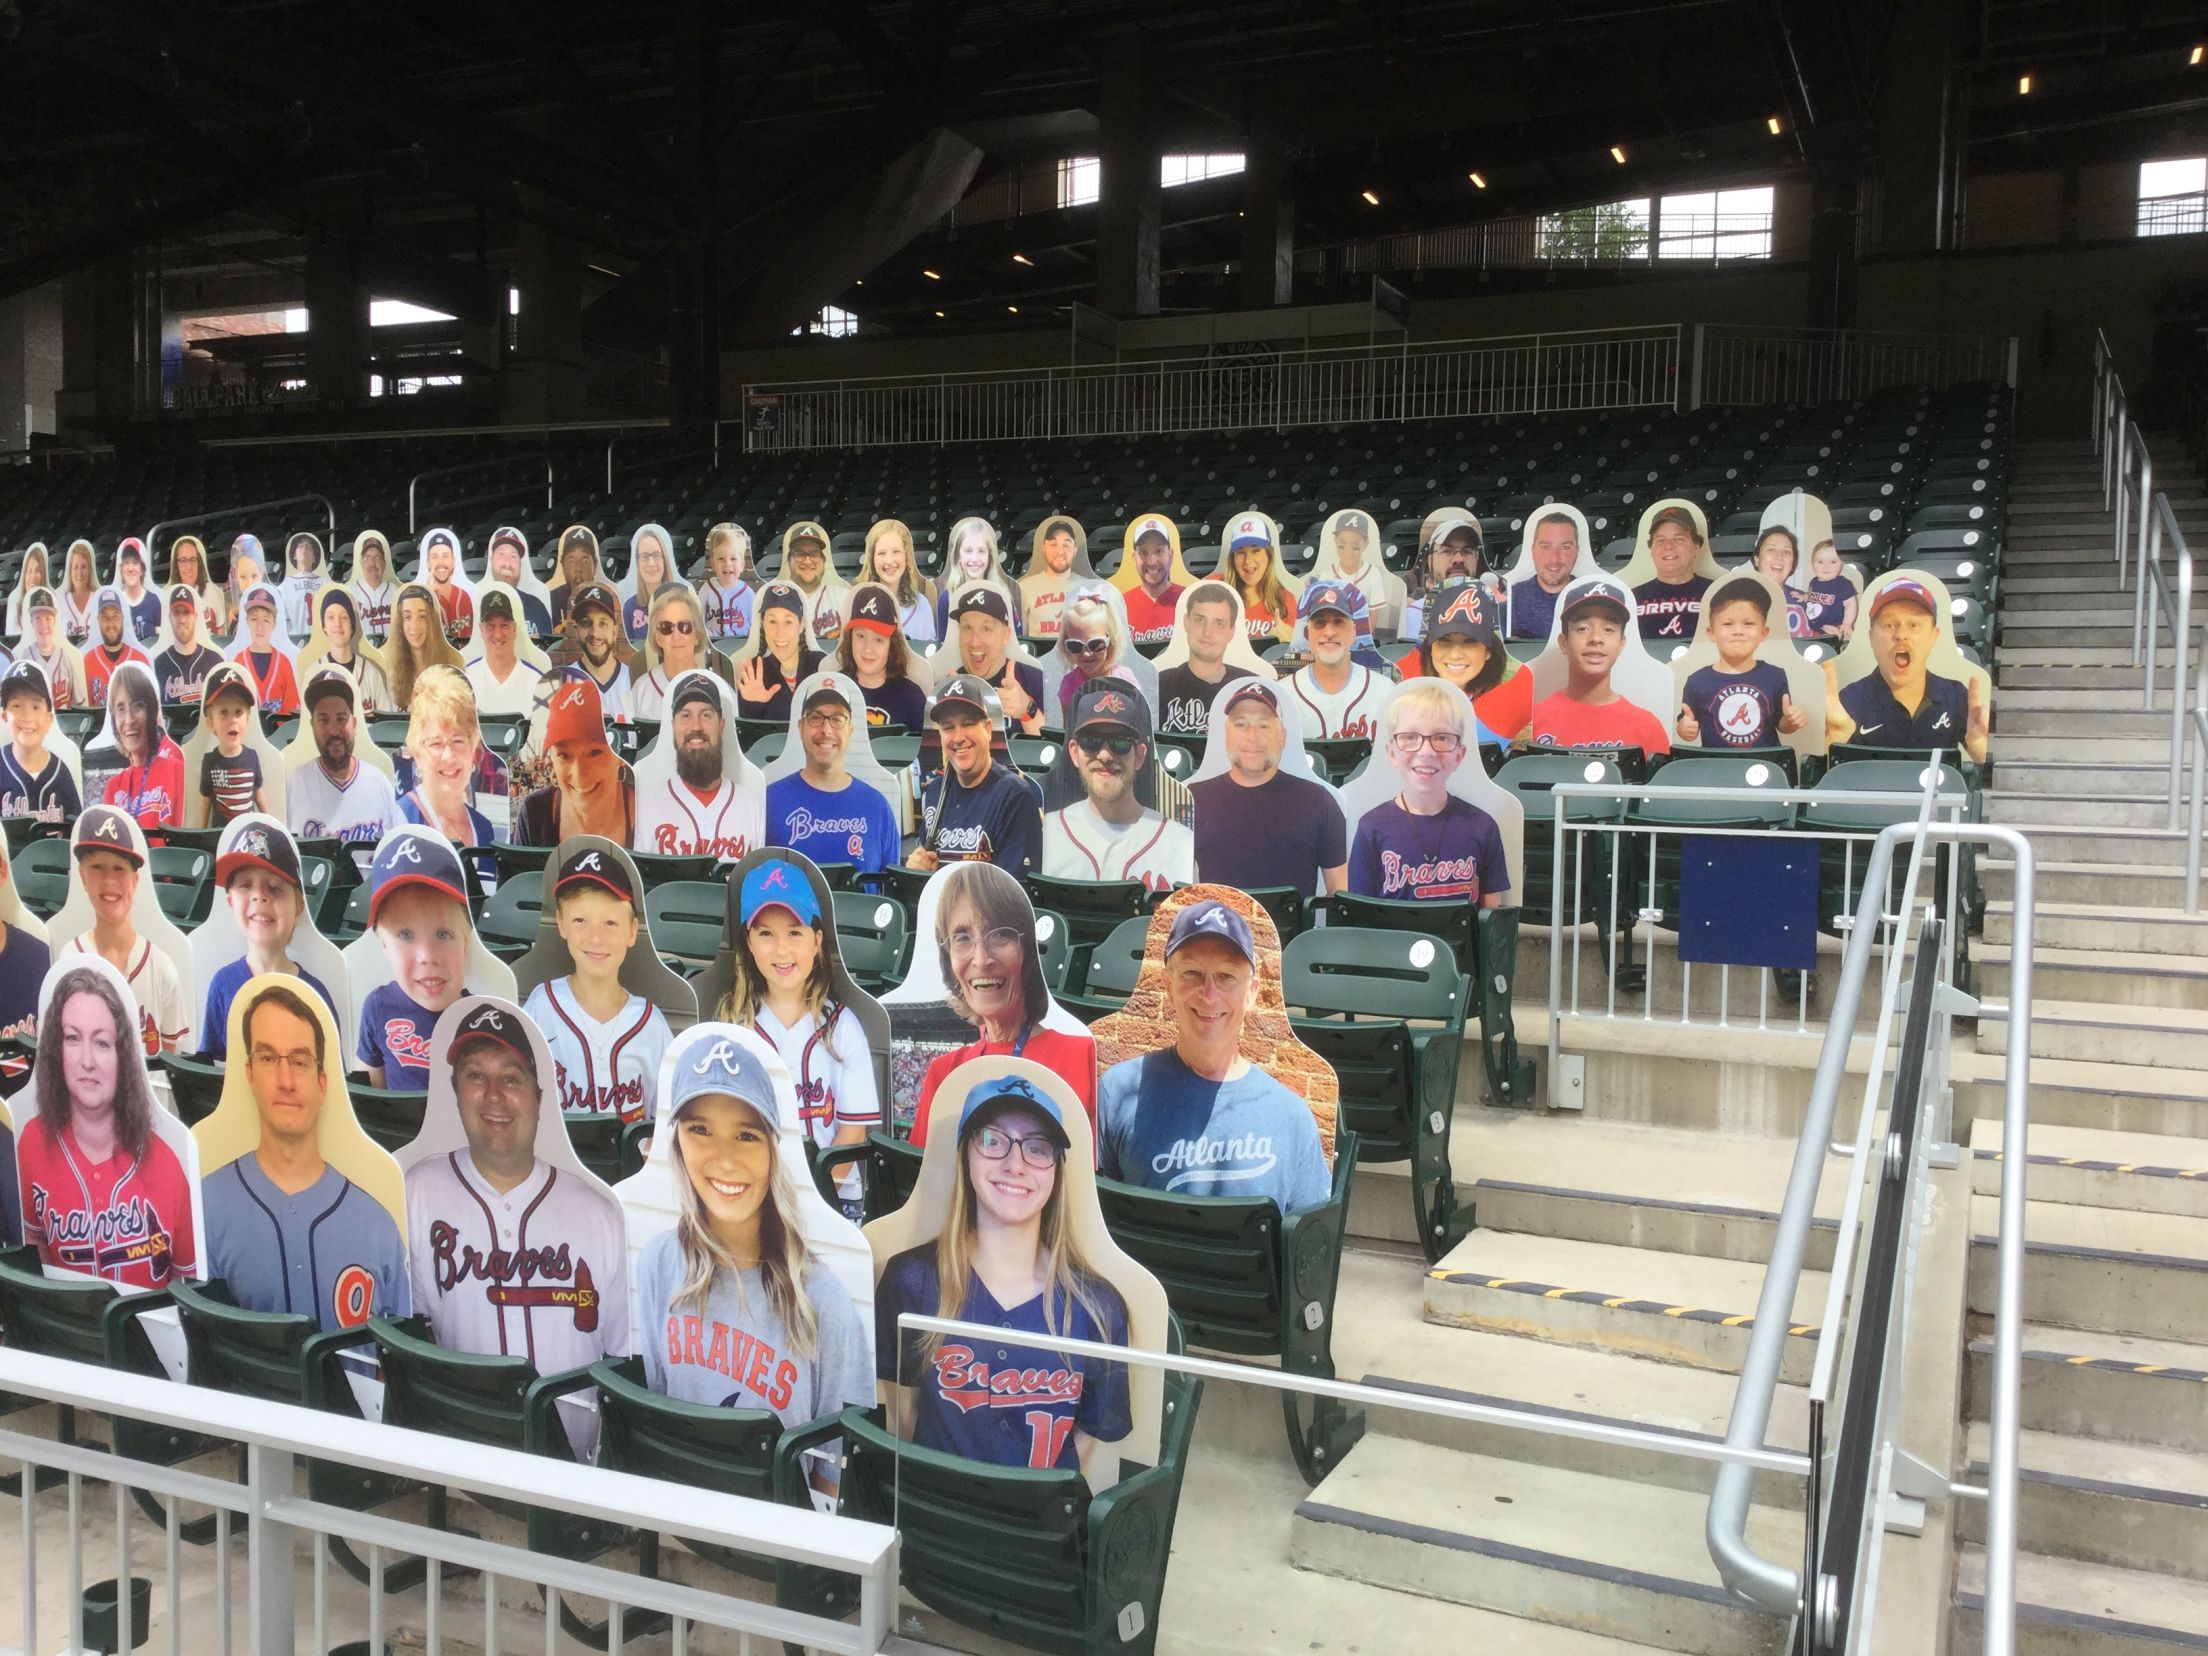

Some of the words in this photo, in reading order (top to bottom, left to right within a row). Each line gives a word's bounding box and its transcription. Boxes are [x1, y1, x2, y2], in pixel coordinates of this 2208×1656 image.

[1345, 515, 1358, 528] A
[572, 528, 585, 540] A
[175, 588, 187, 599] A
[585, 588, 601, 599] A
[967, 591, 985, 605] A
[1584, 582, 1608, 597] A
[1808, 591, 1836, 605] raves
[860, 597, 878, 615] A
[1438, 588, 1482, 625] A
[1658, 614, 1683, 635] A
[12, 662, 29, 677] A
[220, 669, 242, 684] A
[944, 679, 964, 697] A
[1242, 682, 1262, 694] A
[1718, 686, 1761, 701] ATLANTA
[559, 688, 585, 711] A
[1726, 702, 1752, 728] A
[1931, 711, 1951, 729] A
[1720, 726, 1763, 745] BASEBALL
[95, 817, 118, 839] A
[786, 806, 868, 847] Braves
[923, 805, 982, 850] Baves
[386, 837, 422, 870] A
[574, 851, 601, 873] A
[763, 867, 789, 890] A
[1381, 850, 1476, 893] Braves
[1194, 906, 1228, 930] A
[469, 1009, 503, 1030] A
[693, 1040, 741, 1076] A
[996, 1076, 1035, 1100] A
[1151, 1132, 1278, 1174] Atlanta
[430, 1219, 573, 1299] Braves
[1310, 1307, 1319, 1325] 2
[667, 1314, 798, 1411] BRAVES
[931, 1344, 1084, 1398] Braves
